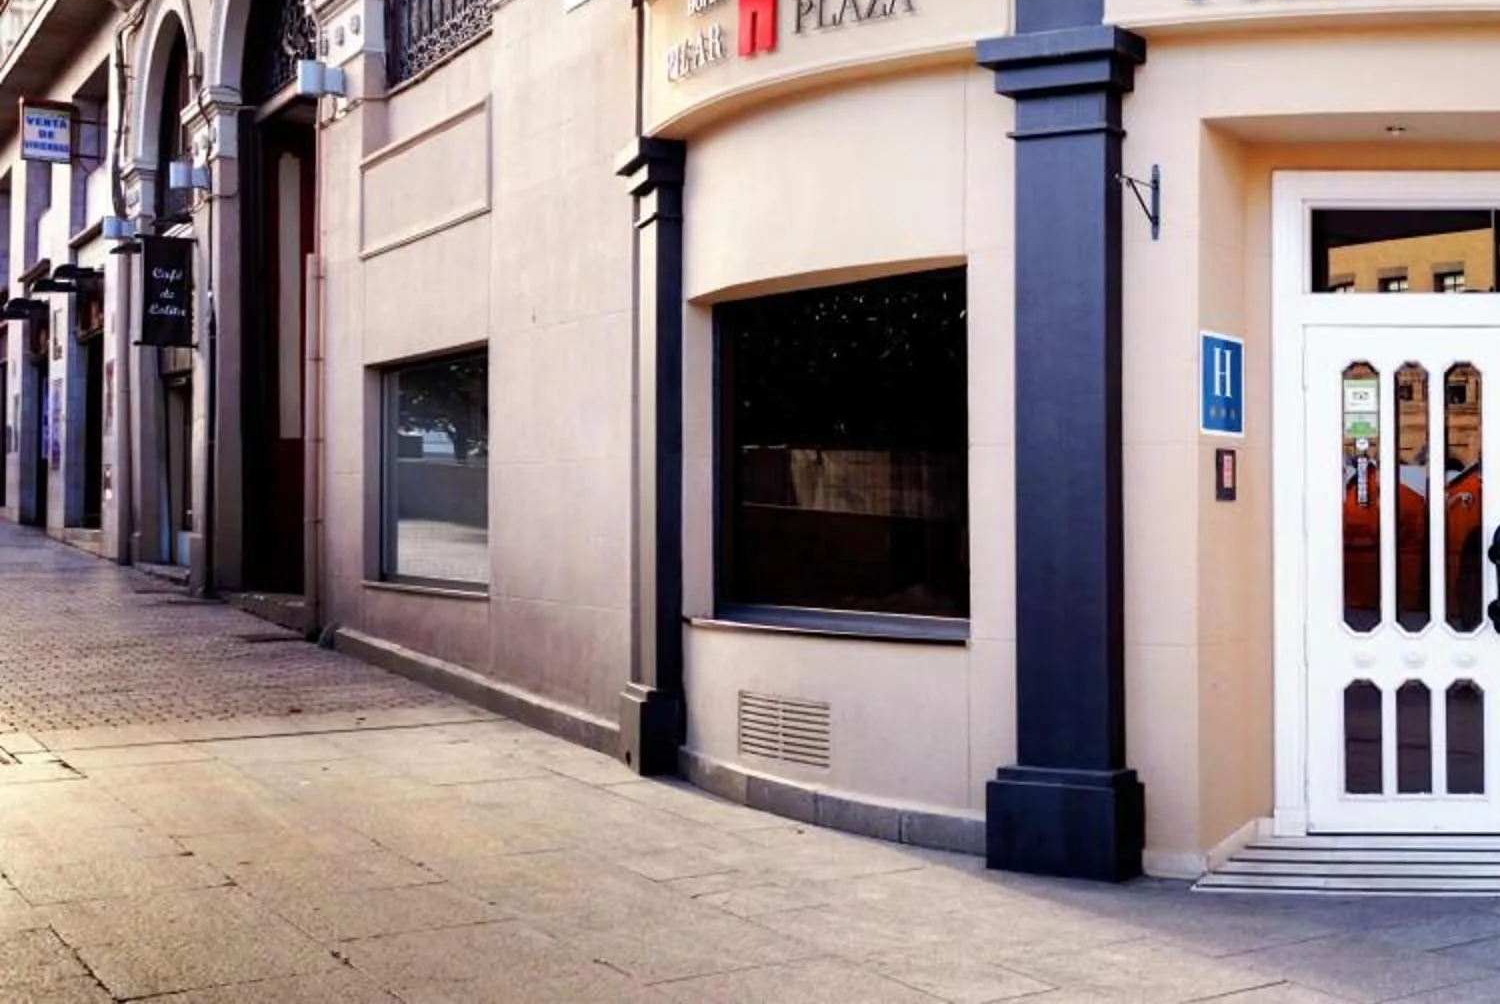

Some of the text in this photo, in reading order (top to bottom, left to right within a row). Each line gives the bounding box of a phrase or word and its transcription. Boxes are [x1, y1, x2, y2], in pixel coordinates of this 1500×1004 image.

[26, 115, 68, 129] VENTA
[38, 128, 54, 140] DE
[1213, 346, 1233, 398] H
